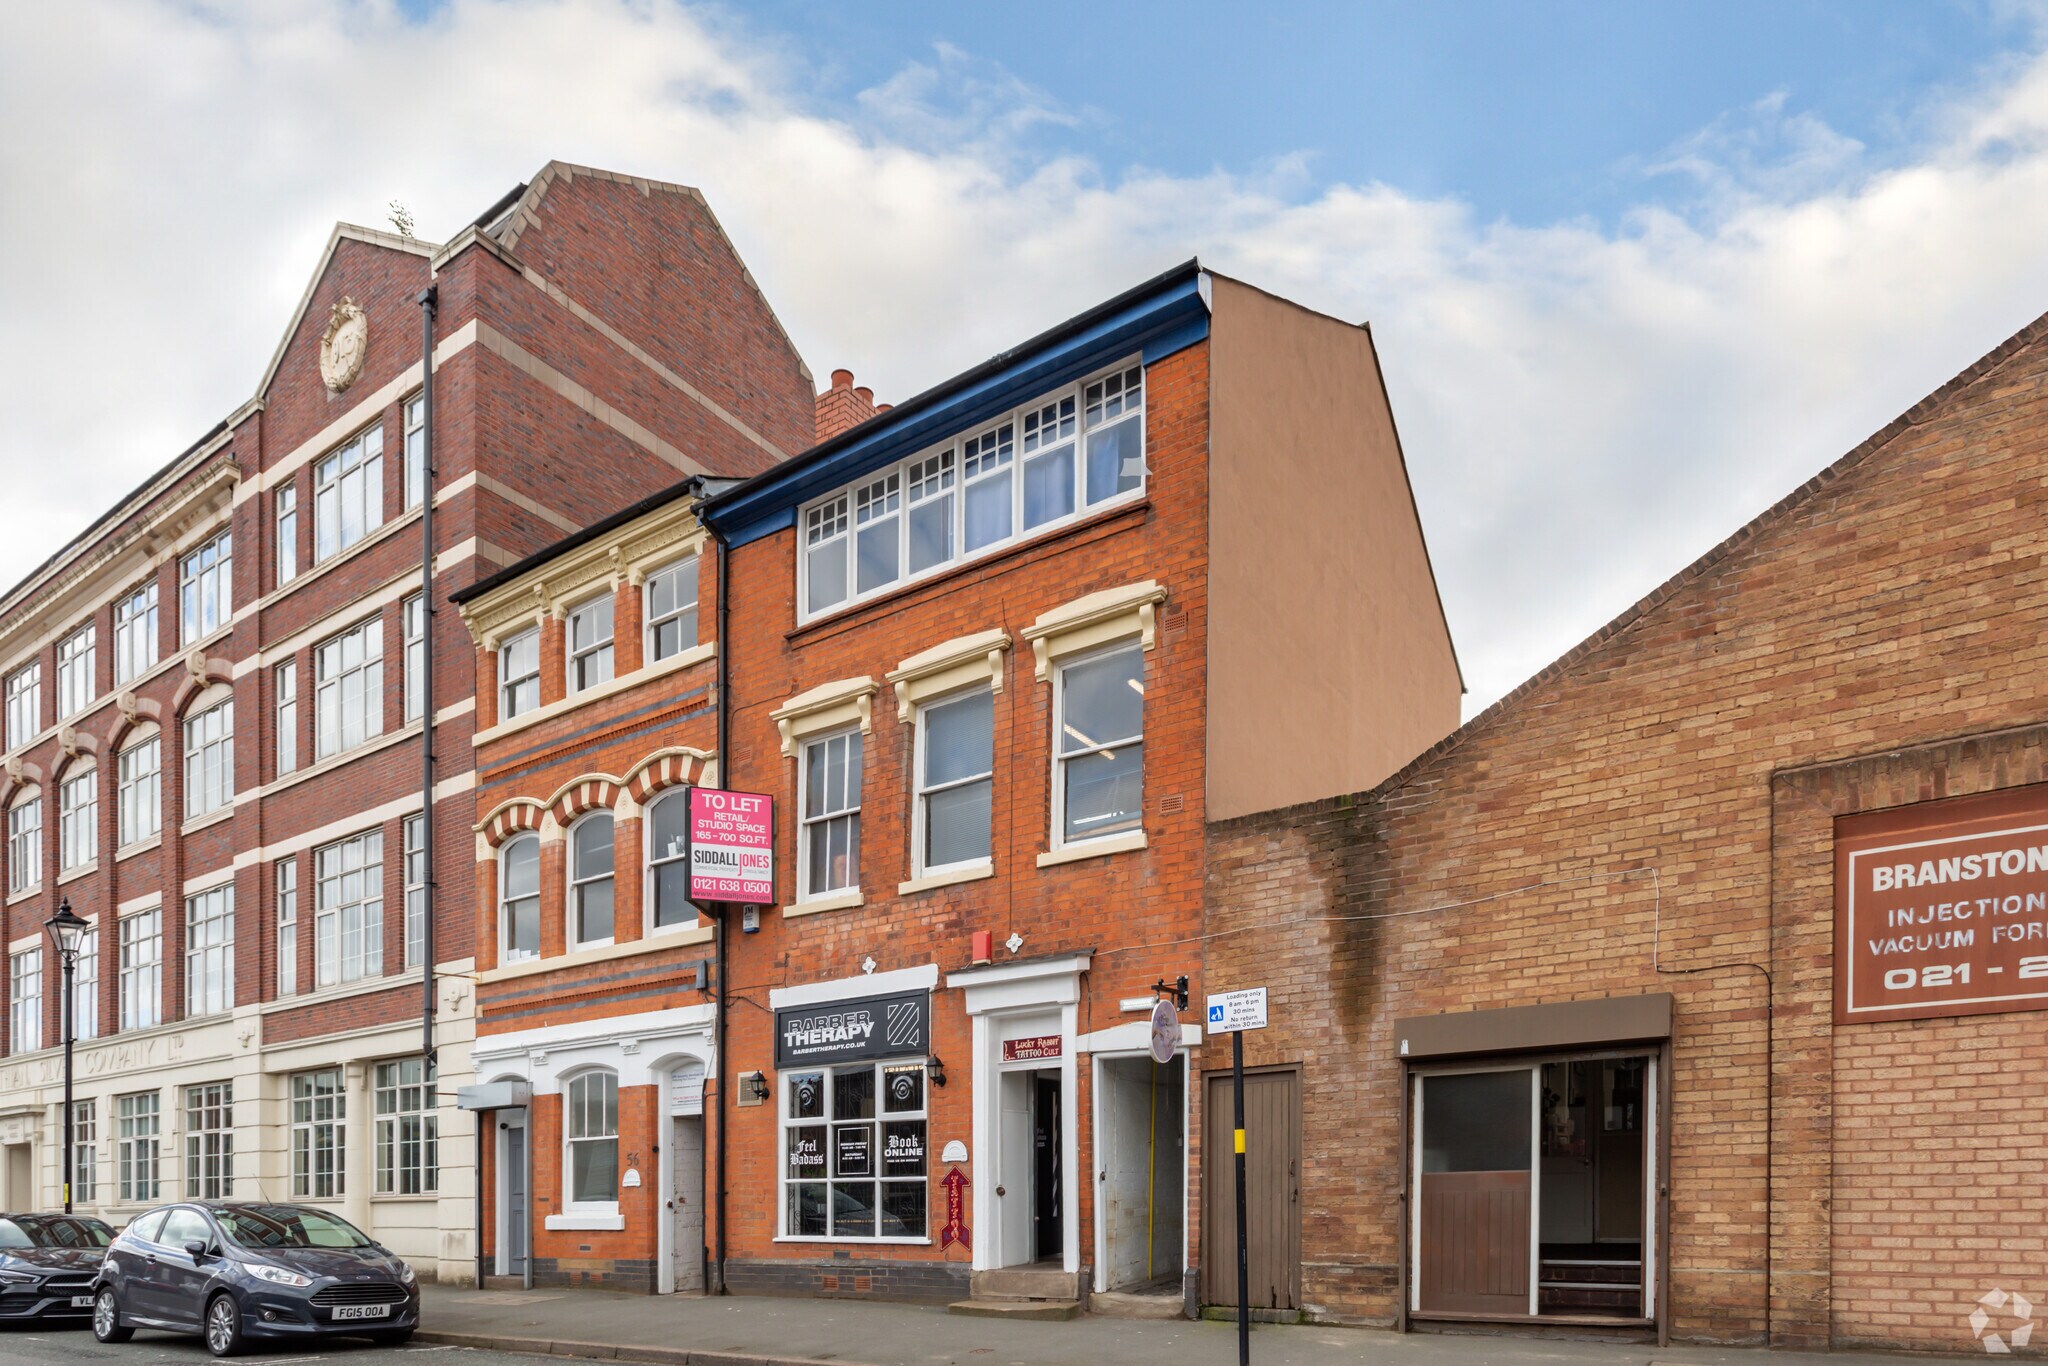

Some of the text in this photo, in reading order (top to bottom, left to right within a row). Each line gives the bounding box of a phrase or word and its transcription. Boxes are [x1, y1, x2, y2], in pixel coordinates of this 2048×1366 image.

[702, 793, 762, 812] TO LET
[714, 812, 750, 823] RETAIL/
[698, 819, 766, 834] STUDIO SPACE
[695, 831, 711, 839] 165
[719, 832, 737, 842] 700
[739, 834, 769, 845] SQ.FT.
[1872, 845, 2048, 892] BRANSTON
[693, 878, 771, 894] 0121 638 0500
[1888, 892, 2046, 928] INJECTION
[1868, 922, 2048, 957] VACUUM FOR
[1883, 962, 1971, 990] 021
[788, 1011, 870, 1033] BARBER
[784, 1021, 875, 1047] THERAPY
[792, 1041, 866, 1055] BARBERTHERAPY.CO.UK
[1015, 1049, 1042, 1058] TATTOO
[795, 1140, 817, 1154] Feel
[888, 1134, 918, 1148] Book
[626, 1151, 640, 1167] 56
[884, 1147, 923, 1157] ONLINE
[790, 1153, 824, 1166] Badass
[80, 1297, 95, 1305] VL
[339, 1308, 362, 1318] FG15
